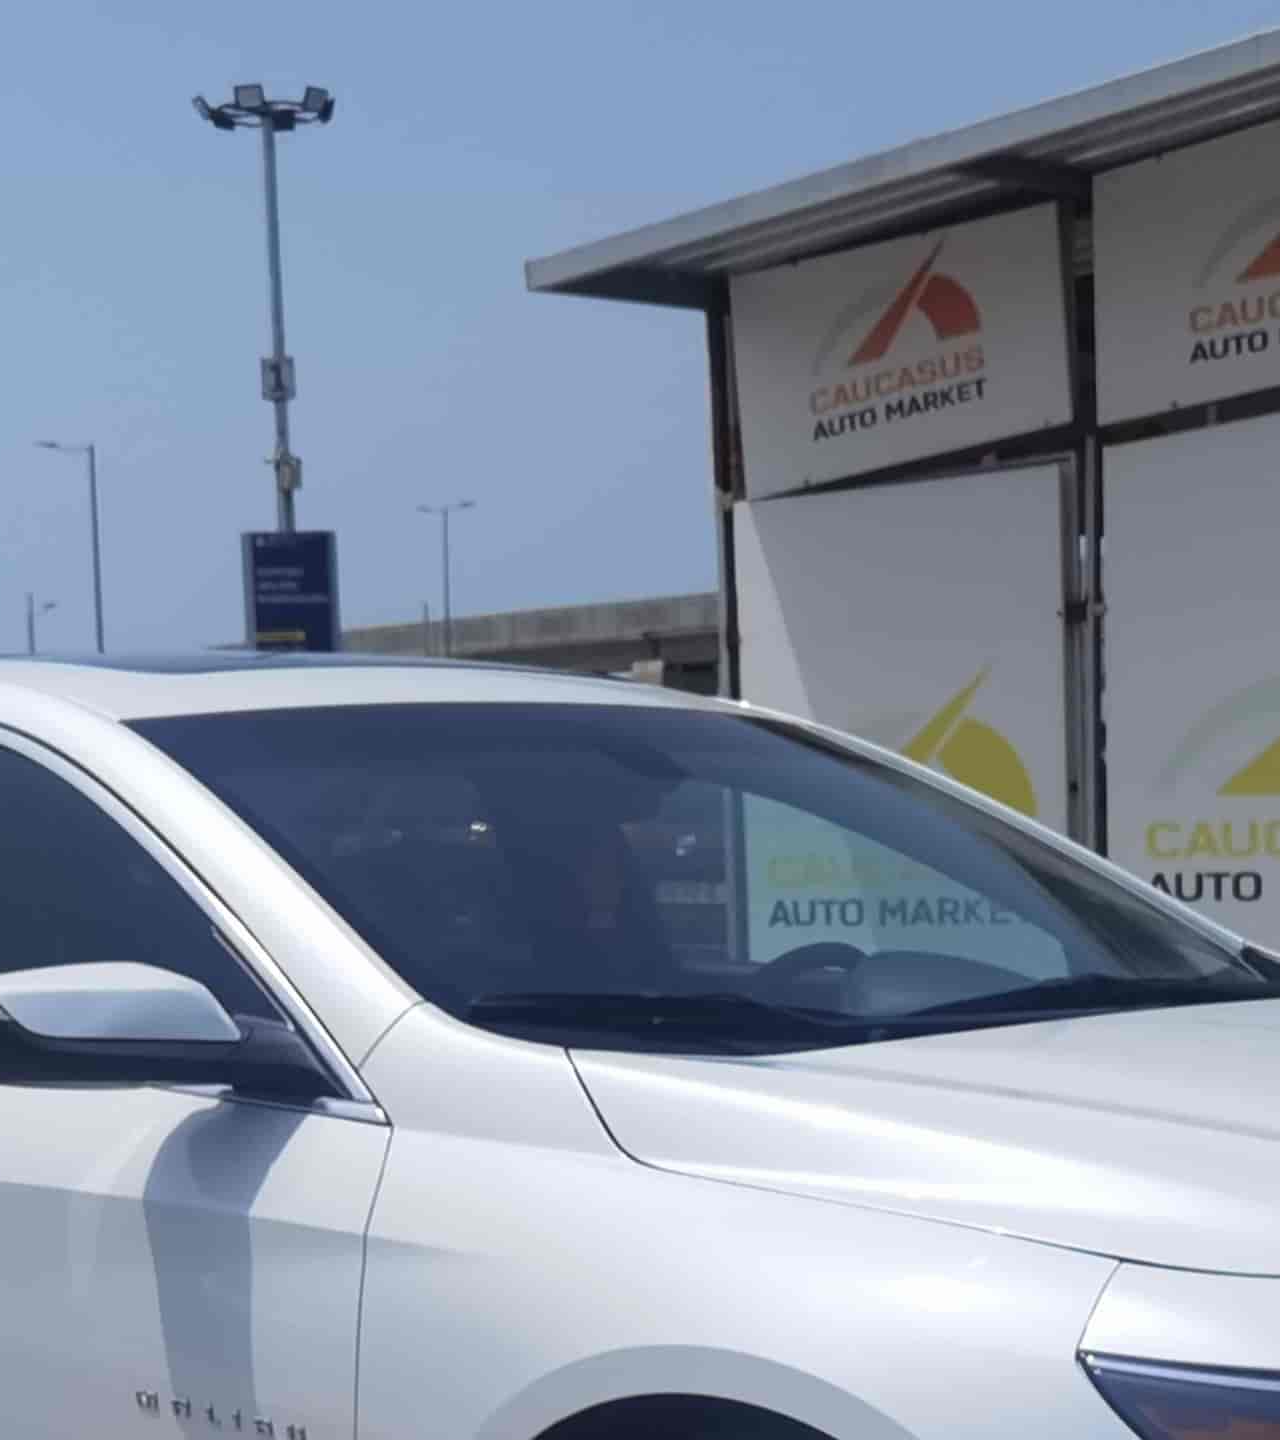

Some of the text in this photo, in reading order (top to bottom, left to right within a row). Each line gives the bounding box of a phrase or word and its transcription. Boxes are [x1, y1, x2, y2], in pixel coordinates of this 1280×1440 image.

[1188, 326, 1270, 365] AUTO
[810, 345, 985, 416] CAUCASUS
[811, 378, 988, 442] AUTO MARKET
[768, 896, 1016, 928] AUTO MARK
